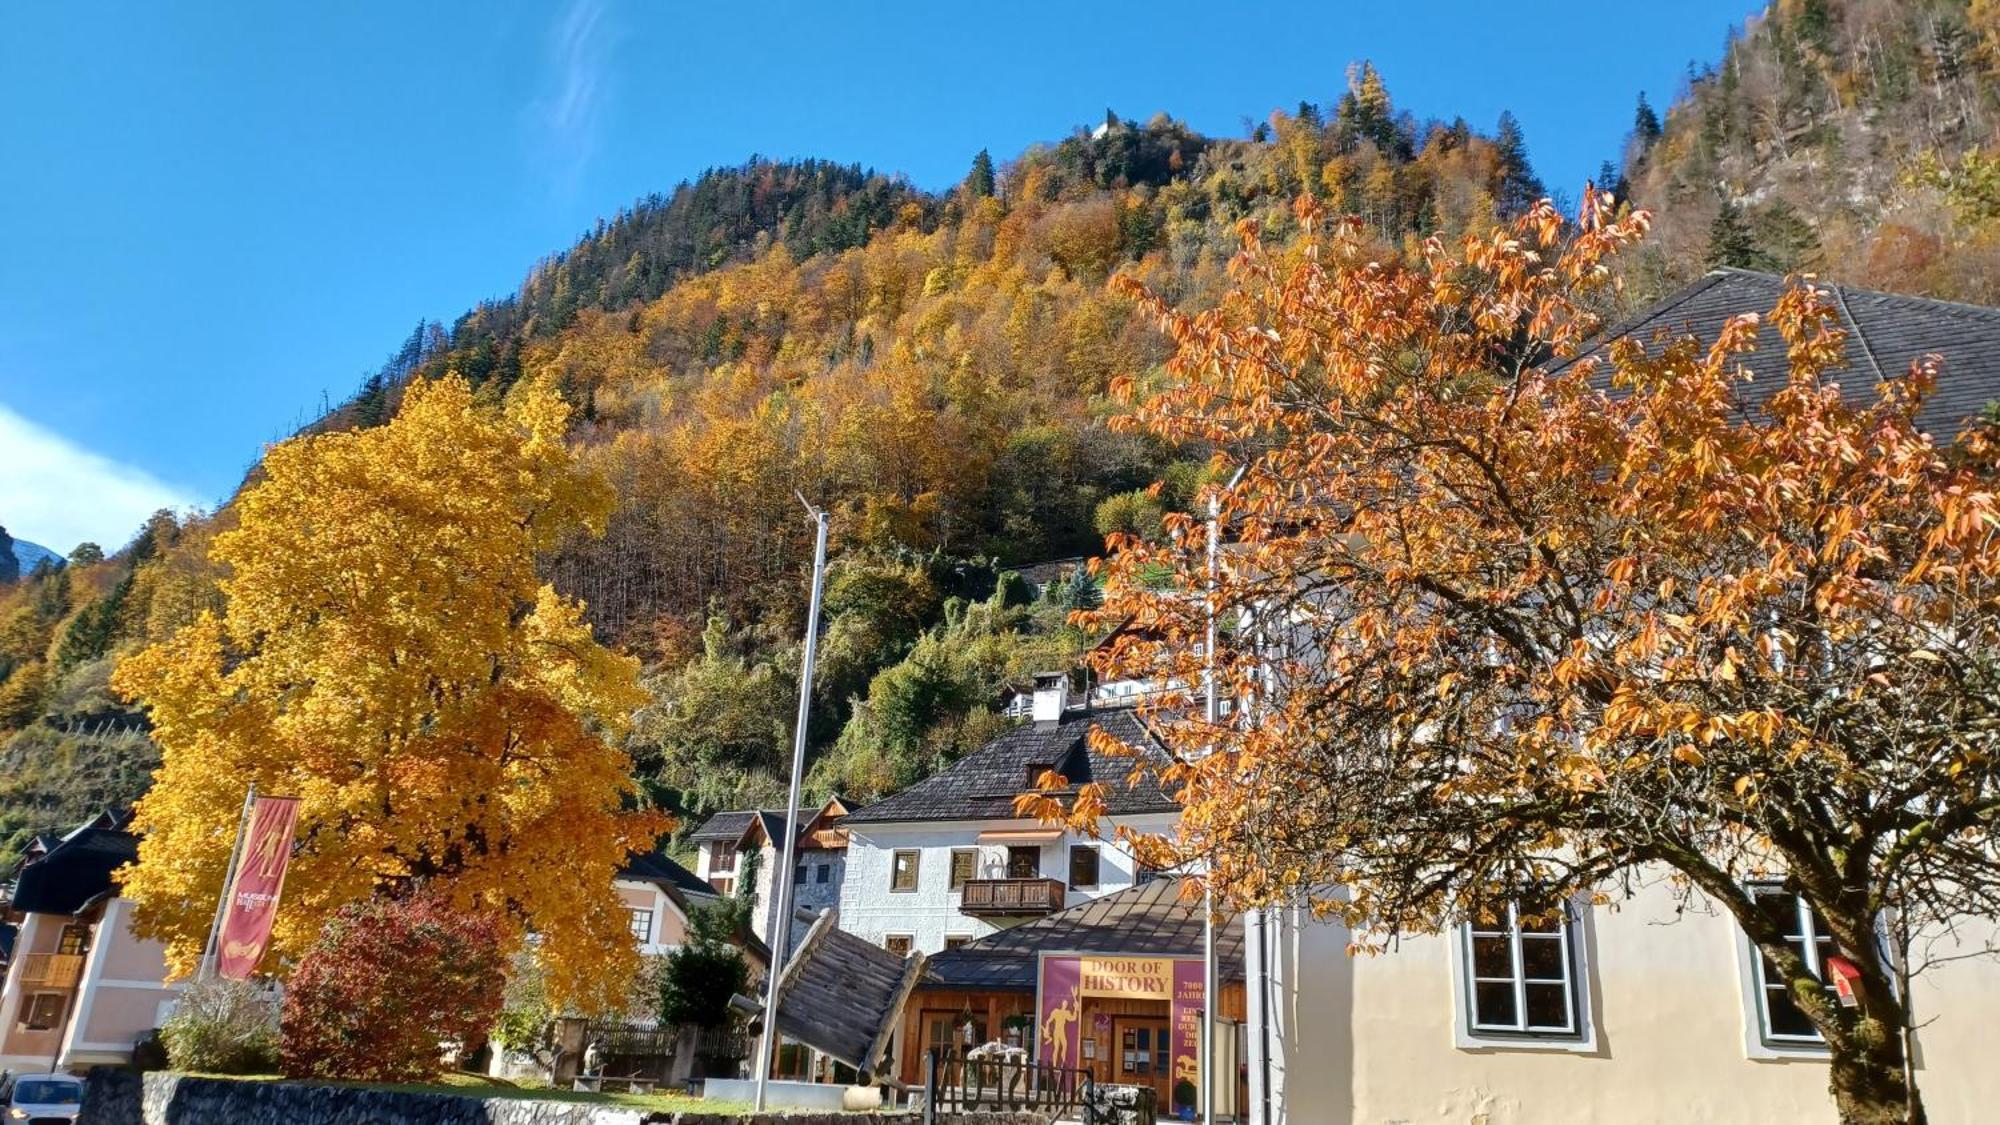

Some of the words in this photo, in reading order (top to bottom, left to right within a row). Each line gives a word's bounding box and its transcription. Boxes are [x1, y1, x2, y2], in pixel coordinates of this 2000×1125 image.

[1092, 960, 1136, 974] DOOR
[1142, 961, 1163, 974] OF
[1084, 975, 1169, 993] HISTORY
[1183, 981, 1204, 991] 7000
